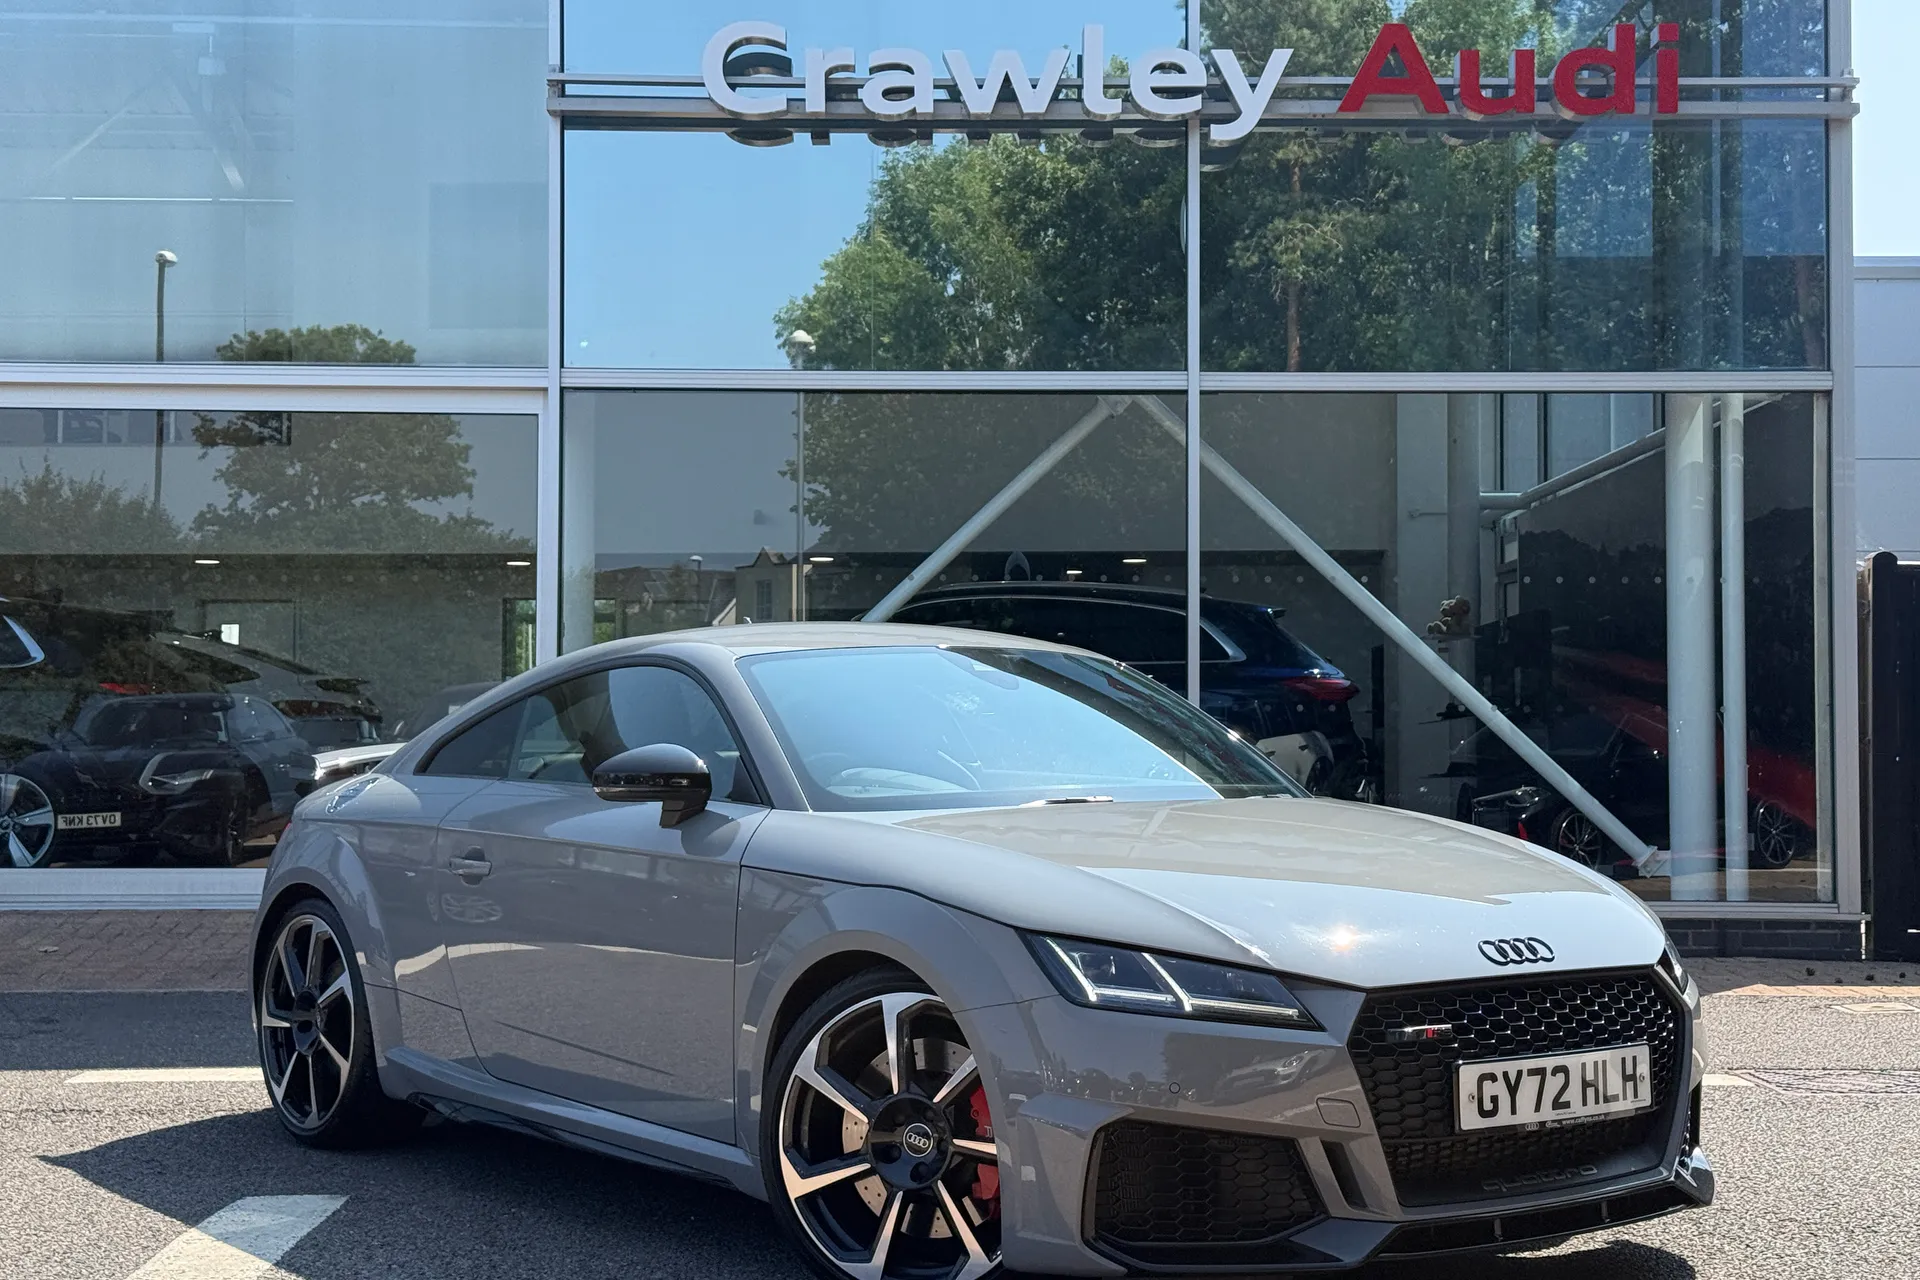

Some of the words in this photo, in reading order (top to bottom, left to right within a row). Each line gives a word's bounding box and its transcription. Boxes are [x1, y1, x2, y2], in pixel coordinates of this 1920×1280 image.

[702, 20, 1294, 142] Crawley
[1337, 22, 1680, 119] Audi
[1476, 1064, 1571, 1119] GY72
[1580, 1055, 1639, 1107] HLH
[1481, 1164, 1598, 1192] quattro
